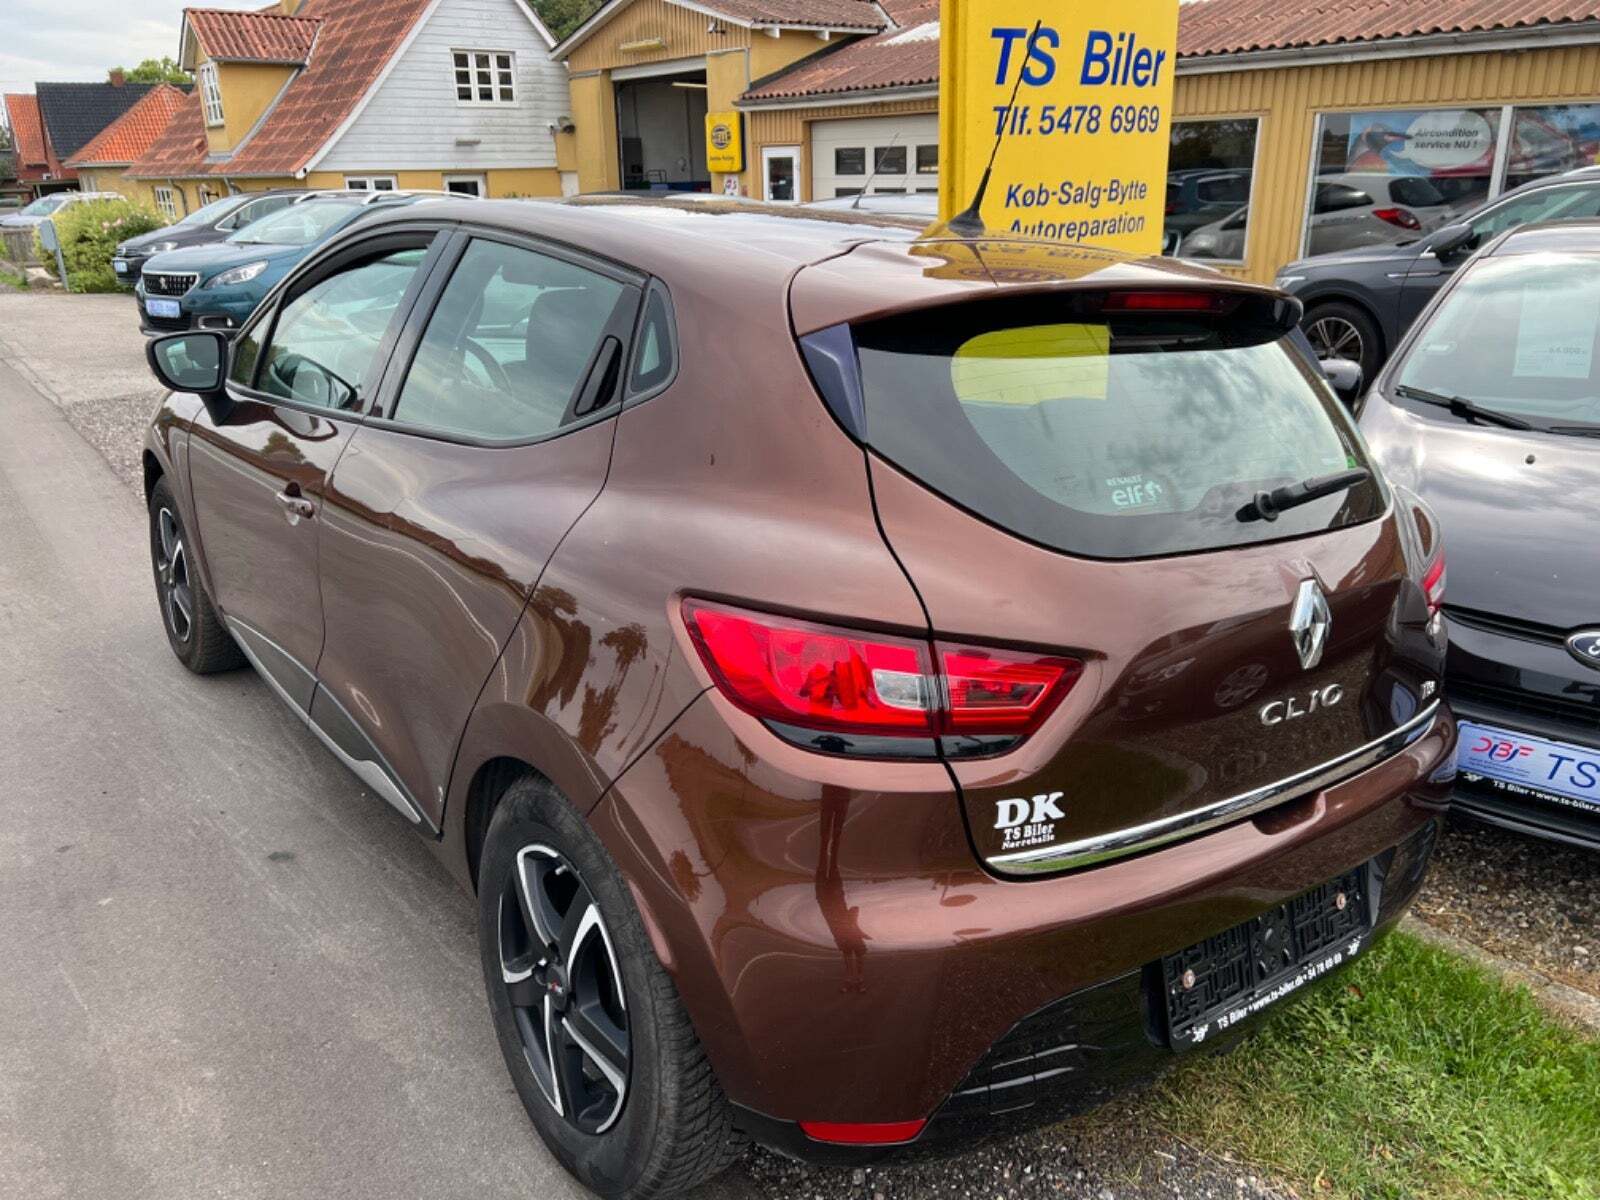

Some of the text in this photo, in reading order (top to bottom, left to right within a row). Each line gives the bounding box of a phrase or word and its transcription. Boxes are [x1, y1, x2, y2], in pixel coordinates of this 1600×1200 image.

[990, 26, 1166, 88] TS Biler
[993, 105, 1160, 136] Tlf. 5478 6969
[1414, 127, 1479, 138] Aircondition
[1414, 140, 1451, 149] service
[1453, 140, 1471, 149] NU
[1005, 179, 1147, 209] Køb-Salg-Bytte
[1010, 212, 1145, 242] Autoreparation
[1111, 484, 1143, 506] elf
[1260, 683, 1343, 726] CLIO
[1547, 753, 1600, 788] TS
[1493, 779, 1506, 790] TS
[1507, 783, 1529, 795] Biler
[993, 791, 1066, 829] DK
[1004, 823, 1055, 841] TS Biler
[1217, 1015, 1229, 1030] TS
